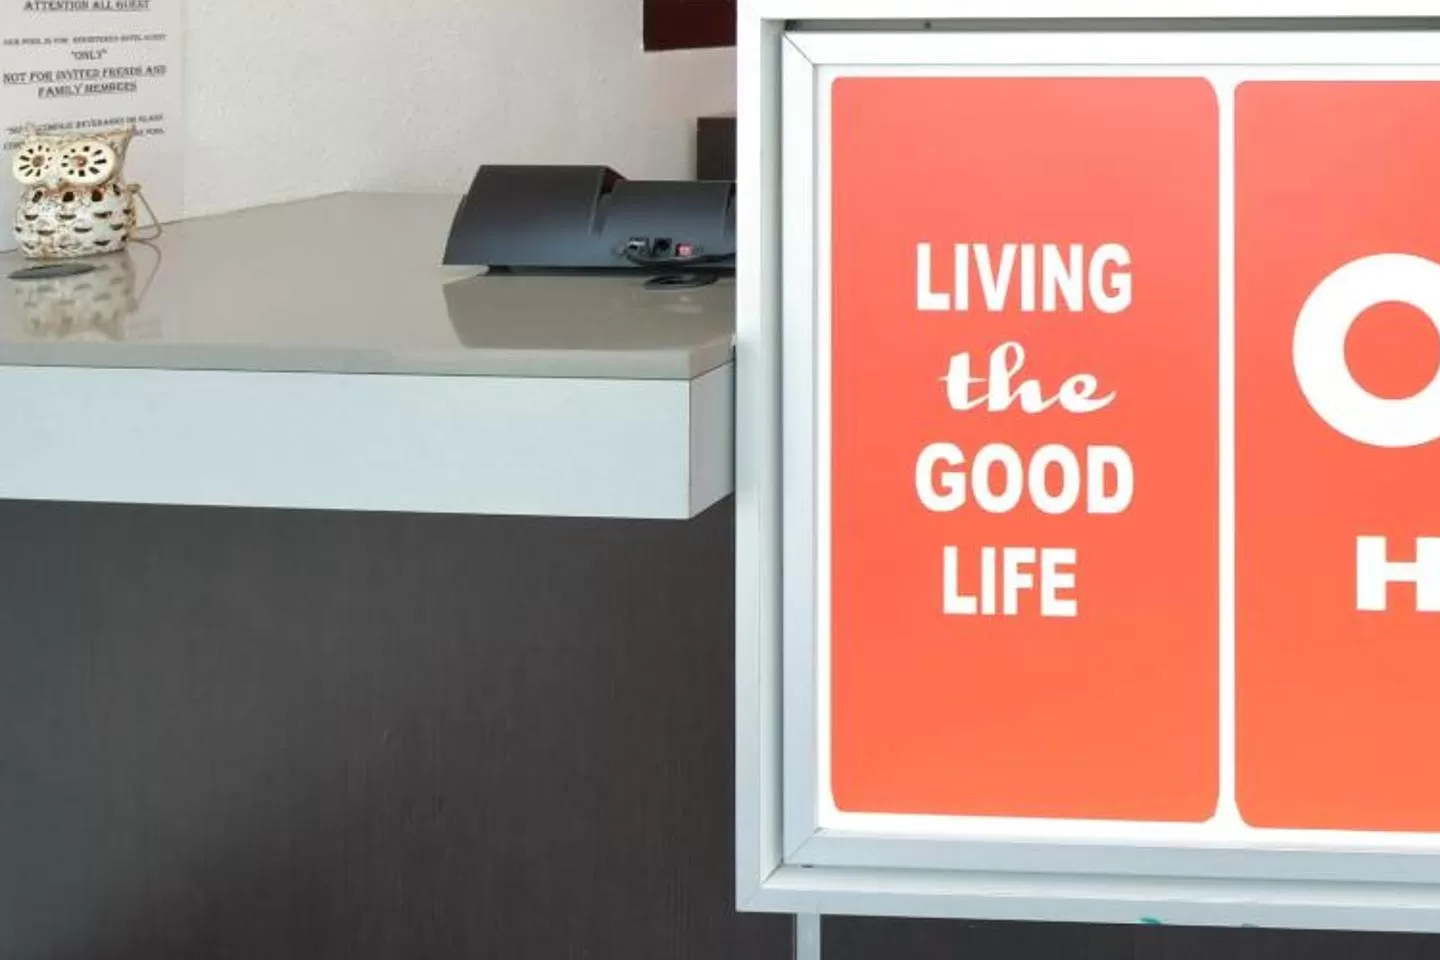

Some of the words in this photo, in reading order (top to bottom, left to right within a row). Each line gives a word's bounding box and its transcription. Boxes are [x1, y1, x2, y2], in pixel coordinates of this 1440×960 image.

[23, 0, 89, 12] ATTENTION
[92, 0, 113, 11] ALL
[115, 0, 151, 12] GUEST
[3, 71, 28, 85] NOT
[29, 70, 53, 83] FOR
[55, 67, 100, 82] INVITED
[145, 65, 167, 78] AND
[37, 83, 83, 99] FAMILY
[915, 243, 1132, 313] LIVING
[941, 343, 1116, 415] the
[914, 444, 1134, 515] GOOD
[942, 547, 1078, 617] LIFE
